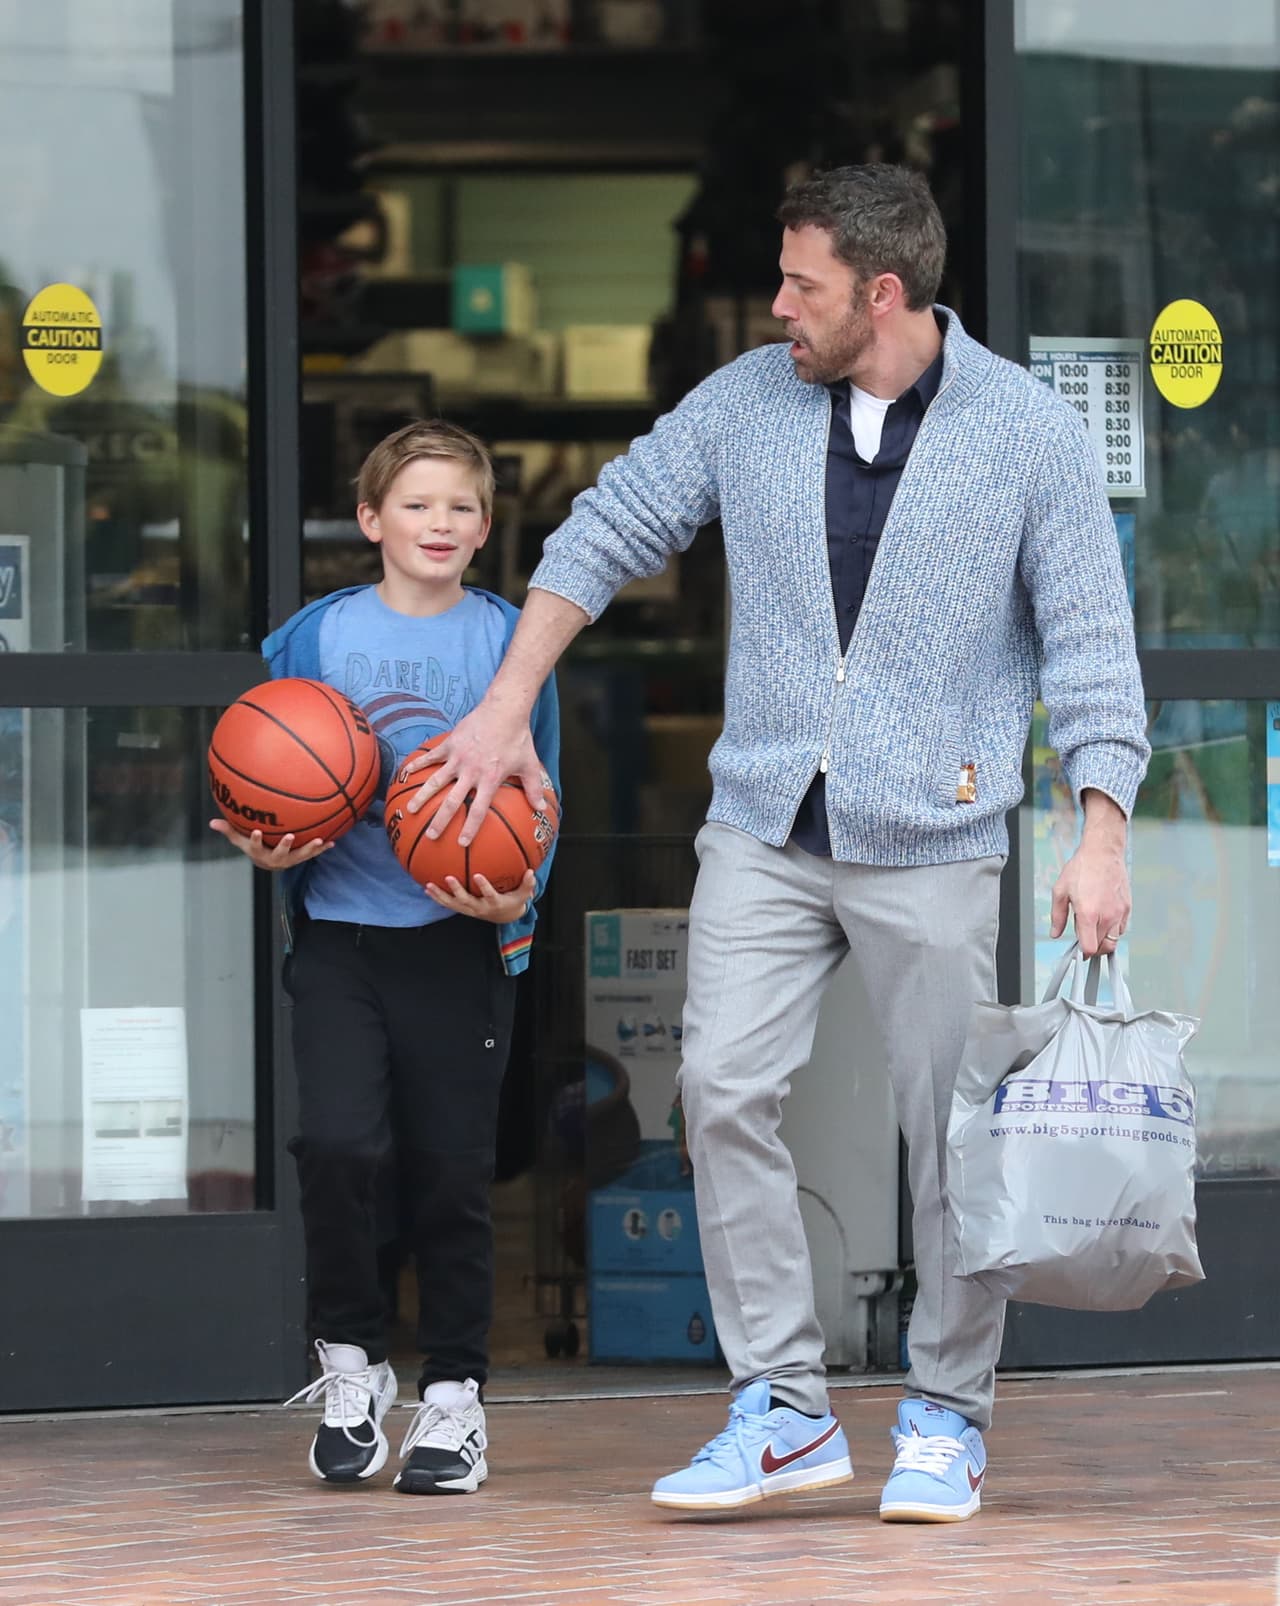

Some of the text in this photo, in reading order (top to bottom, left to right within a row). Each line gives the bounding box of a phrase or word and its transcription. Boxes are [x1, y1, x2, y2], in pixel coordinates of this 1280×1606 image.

[32, 311, 94, 323] AUTOMATIC
[28, 328, 99, 347] CAUTION
[1154, 329, 1218, 342] AUTOMATIC
[47, 352, 77, 364] DOOR
[1050, 352, 1078, 361] HOURS
[1151, 344, 1222, 363] CAUTION
[1030, 364, 1130, 378] ON 10:00 8:30
[1171, 365, 1203, 379] DOOR
[1059, 382, 1130, 396] 10:00 8:30
[1105, 400, 1130, 413] 8:30
[1106, 418, 1131, 432] 8:30
[1106, 435, 1131, 448] 9:00
[1107, 452, 1132, 465] 9:00
[1107, 471, 1132, 484] 8:30
[627, 949, 654, 969] FAST
[656, 949, 677, 970] SET
[1002, 1081, 1191, 1121] BIG 5
[1001, 1102, 1151, 1115] SPORTING GOODS
[1043, 1215, 1068, 1225] This
[1072, 1216, 1092, 1227] bag
[1096, 1217, 1106, 1226] is
